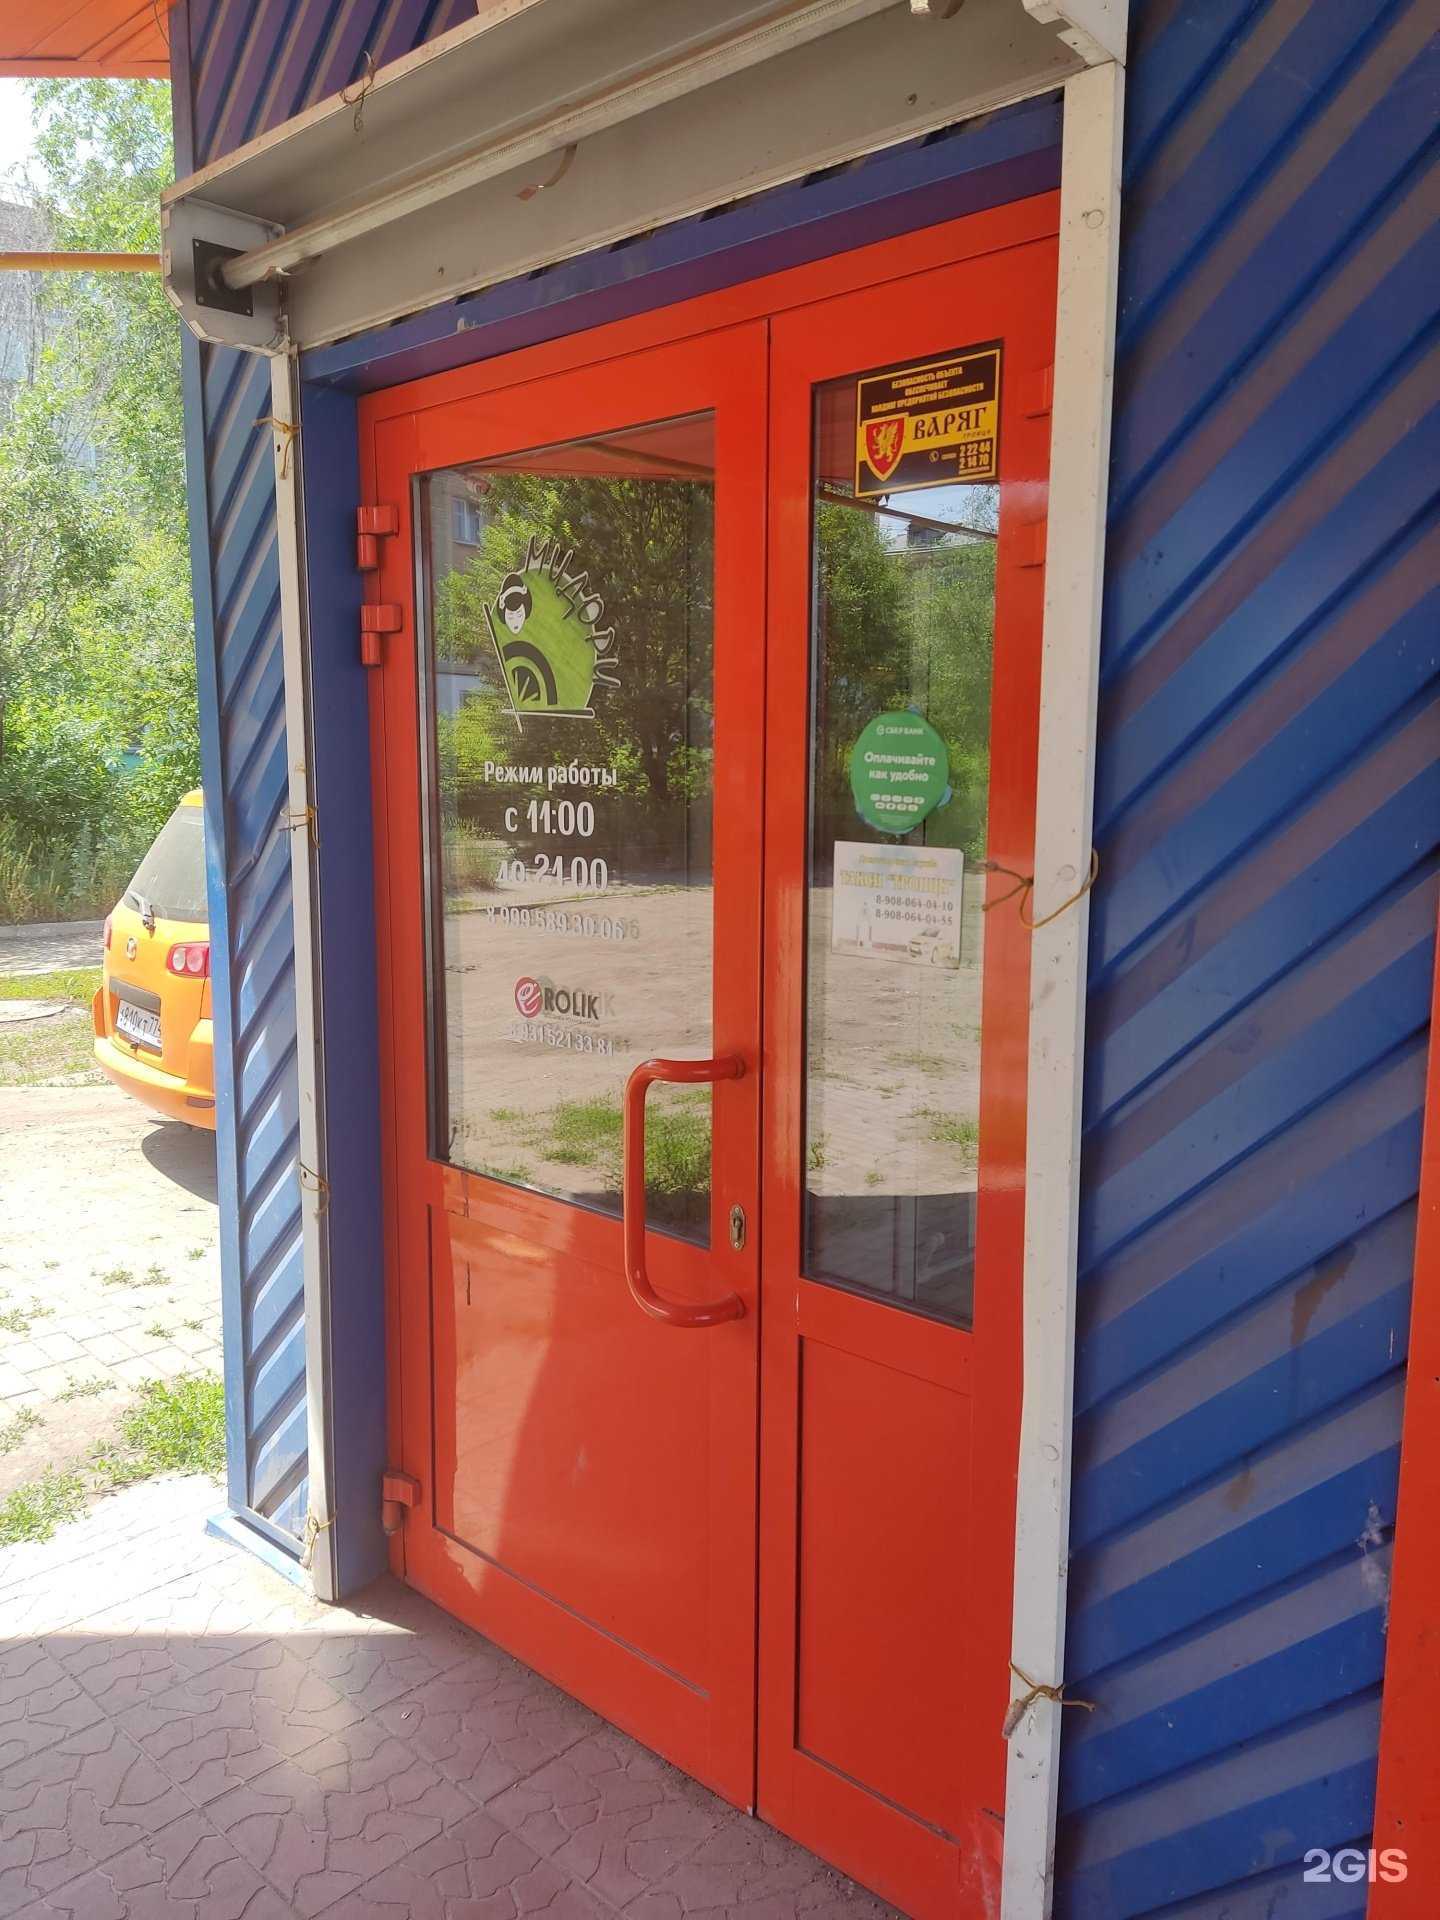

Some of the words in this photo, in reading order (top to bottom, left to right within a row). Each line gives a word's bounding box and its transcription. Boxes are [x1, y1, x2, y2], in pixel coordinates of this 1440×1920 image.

[912, 407, 987, 441] ВАРЯГ
[484, 761, 543, 784] Режим
[547, 758, 617, 791] работы
[864, 751, 936, 767] Оплачивайте
[869, 769, 888, 780] как
[889, 768, 929, 783] удобно
[526, 799, 595, 837] 11:00
[534, 853, 608, 890] 2100
